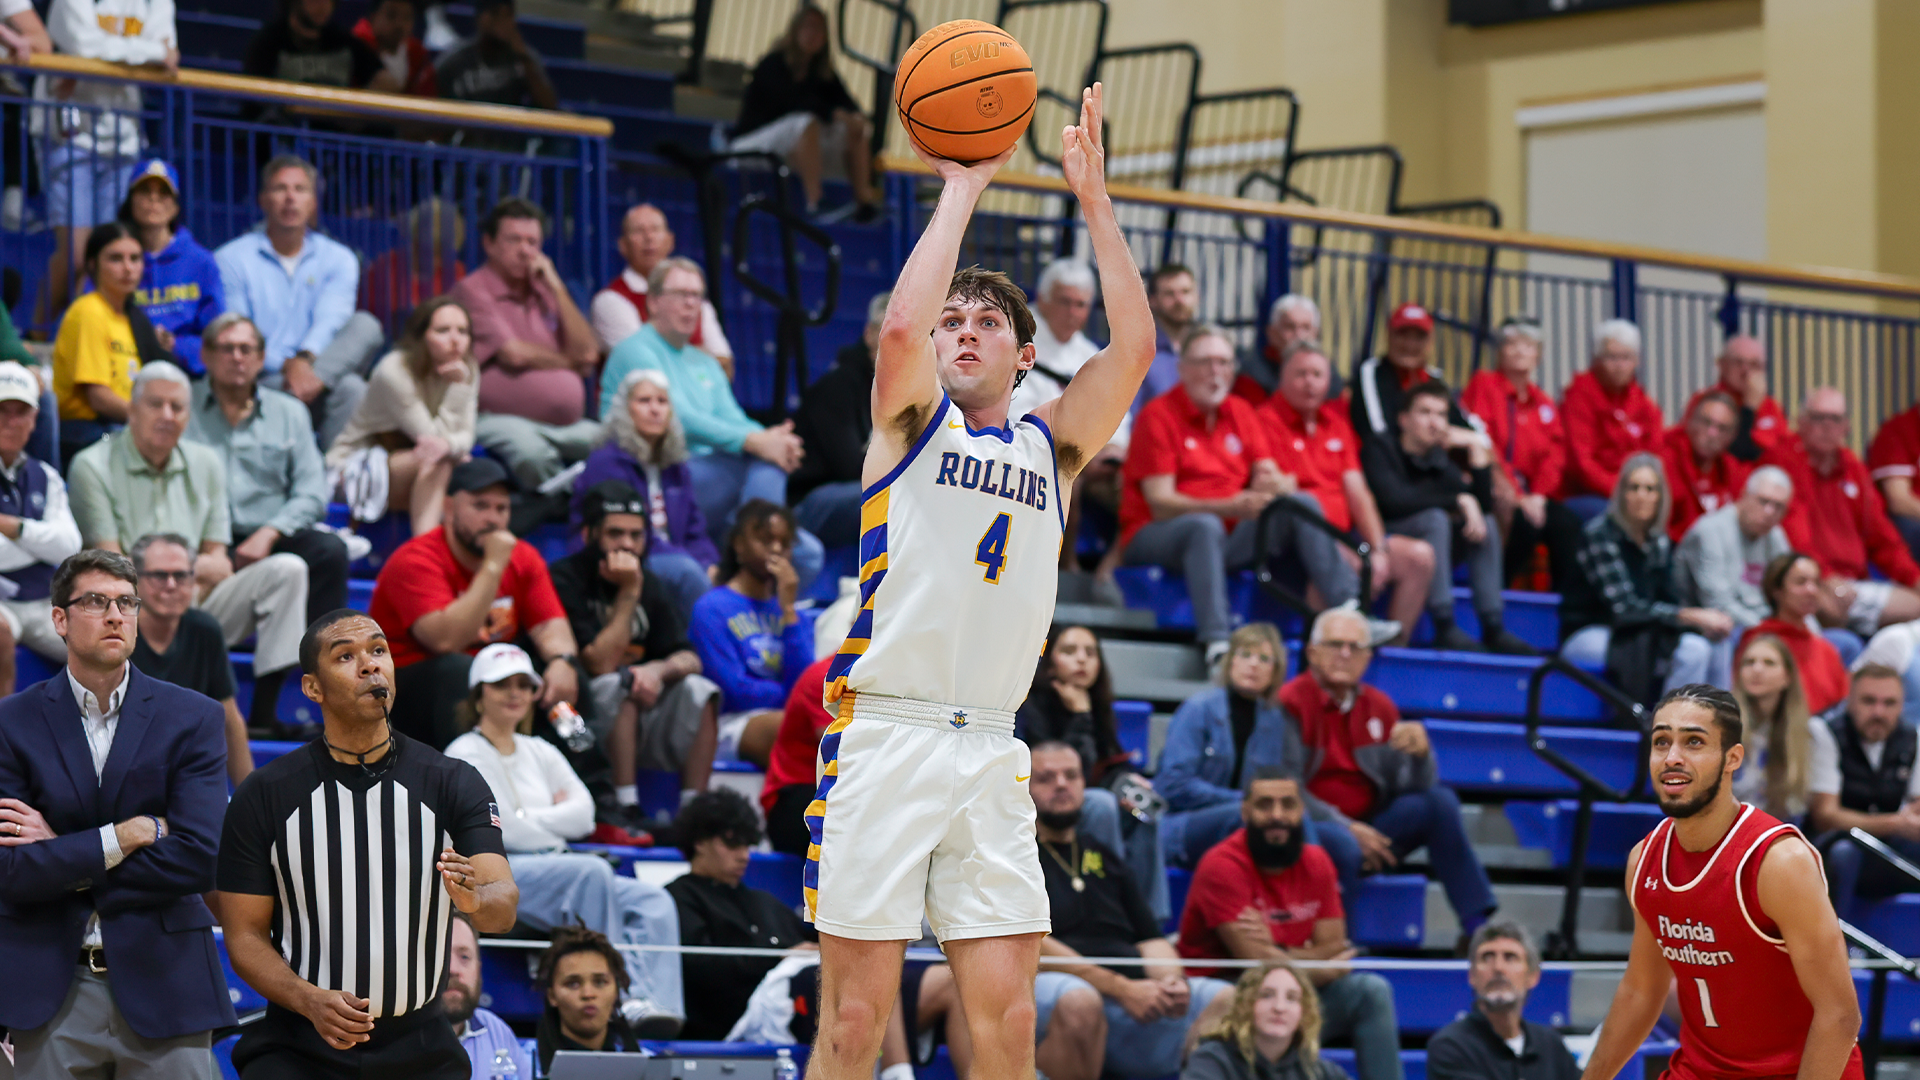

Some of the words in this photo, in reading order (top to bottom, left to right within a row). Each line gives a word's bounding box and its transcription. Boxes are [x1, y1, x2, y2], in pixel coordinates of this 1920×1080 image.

[949, 41, 999, 69] EVO
[935, 451, 1047, 511] ROLLINS
[974, 511, 1013, 585] 4
[1658, 914, 1716, 943] Florida
[1693, 977, 1720, 1028] 1
